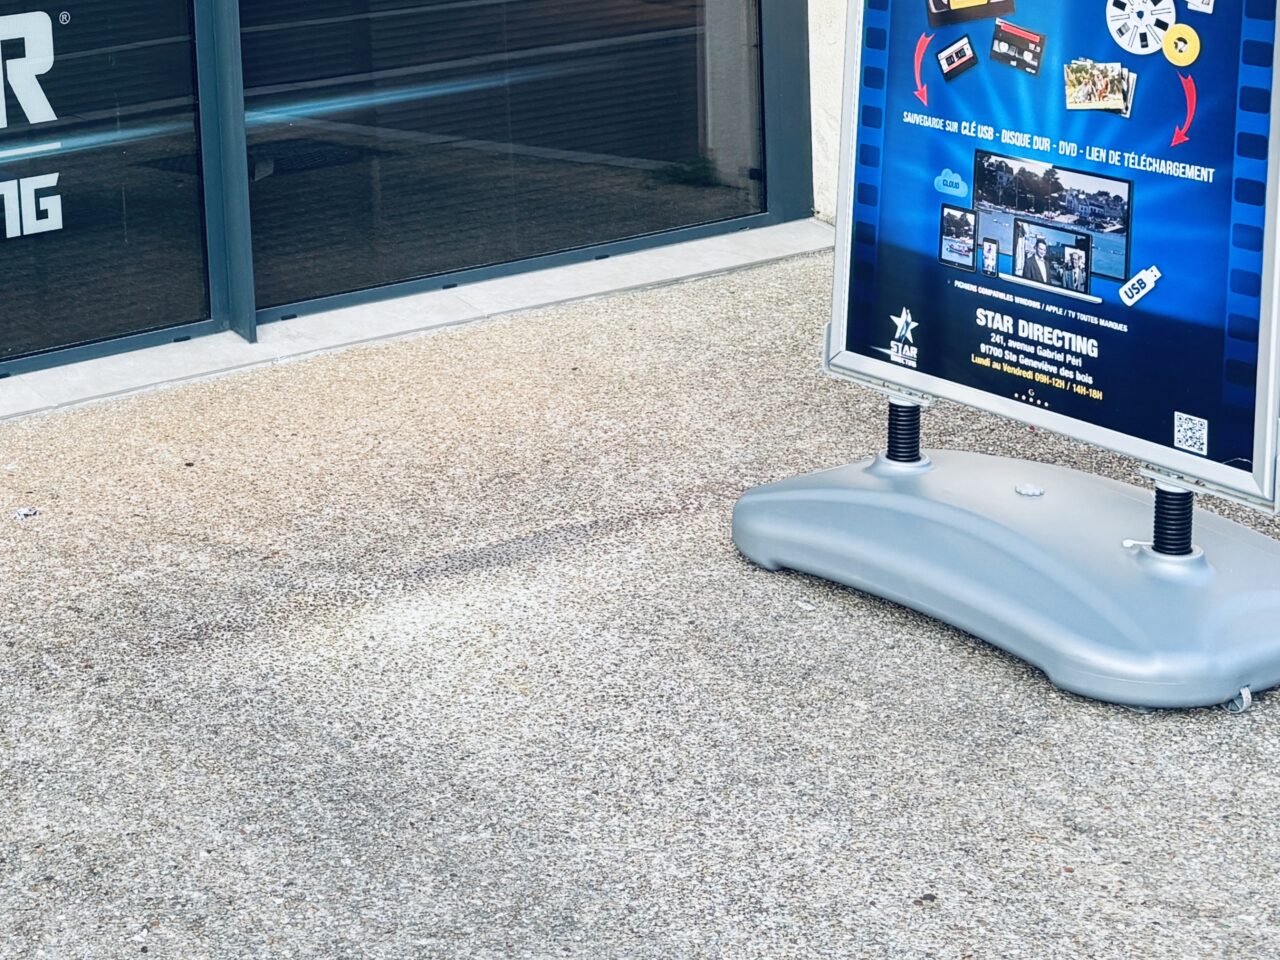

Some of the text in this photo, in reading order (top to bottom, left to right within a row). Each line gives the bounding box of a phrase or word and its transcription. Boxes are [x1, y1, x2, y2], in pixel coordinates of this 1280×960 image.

[903, 111, 944, 131] SAUVEGARDE
[945, 119, 959, 133] SUR
[961, 121, 976, 137] CLÉ
[977, 124, 994, 141] USB
[1001, 129, 1031, 148] DISQUE
[1032, 136, 1051, 152] DUR
[1058, 140, 1077, 157] DVD
[1086, 146, 1107, 163] LIEN
[1108, 150, 1121, 166] DE
[1123, 152, 1215, 183] TÉLÉCHARGEMENT
[942, 178, 960, 190] CLOUD
[1124, 278, 1147, 299] USB
[976, 307, 1098, 358] STAR DIRECTING
[1045, 304, 1063, 316] APPLE
[1067, 309, 1076, 319] TV
[1076, 312, 1099, 324] TOUTES
[1099, 318, 1128, 332] MARQUES
[889, 340, 918, 359] STAR
[990, 332, 1007, 347] 241,
[1007, 339, 1035, 353] avenue
[1036, 346, 1065, 363] Gabriel
[971, 353, 991, 367] Lundi
[991, 359, 1002, 370] au
[1002, 362, 1034, 381] Vendredi
[1034, 372, 1065, 389] 09H-12H
[1072, 384, 1103, 400] 14H-18H
[980, 343, 1094, 385] 91700 Ste Geneviève des bois
